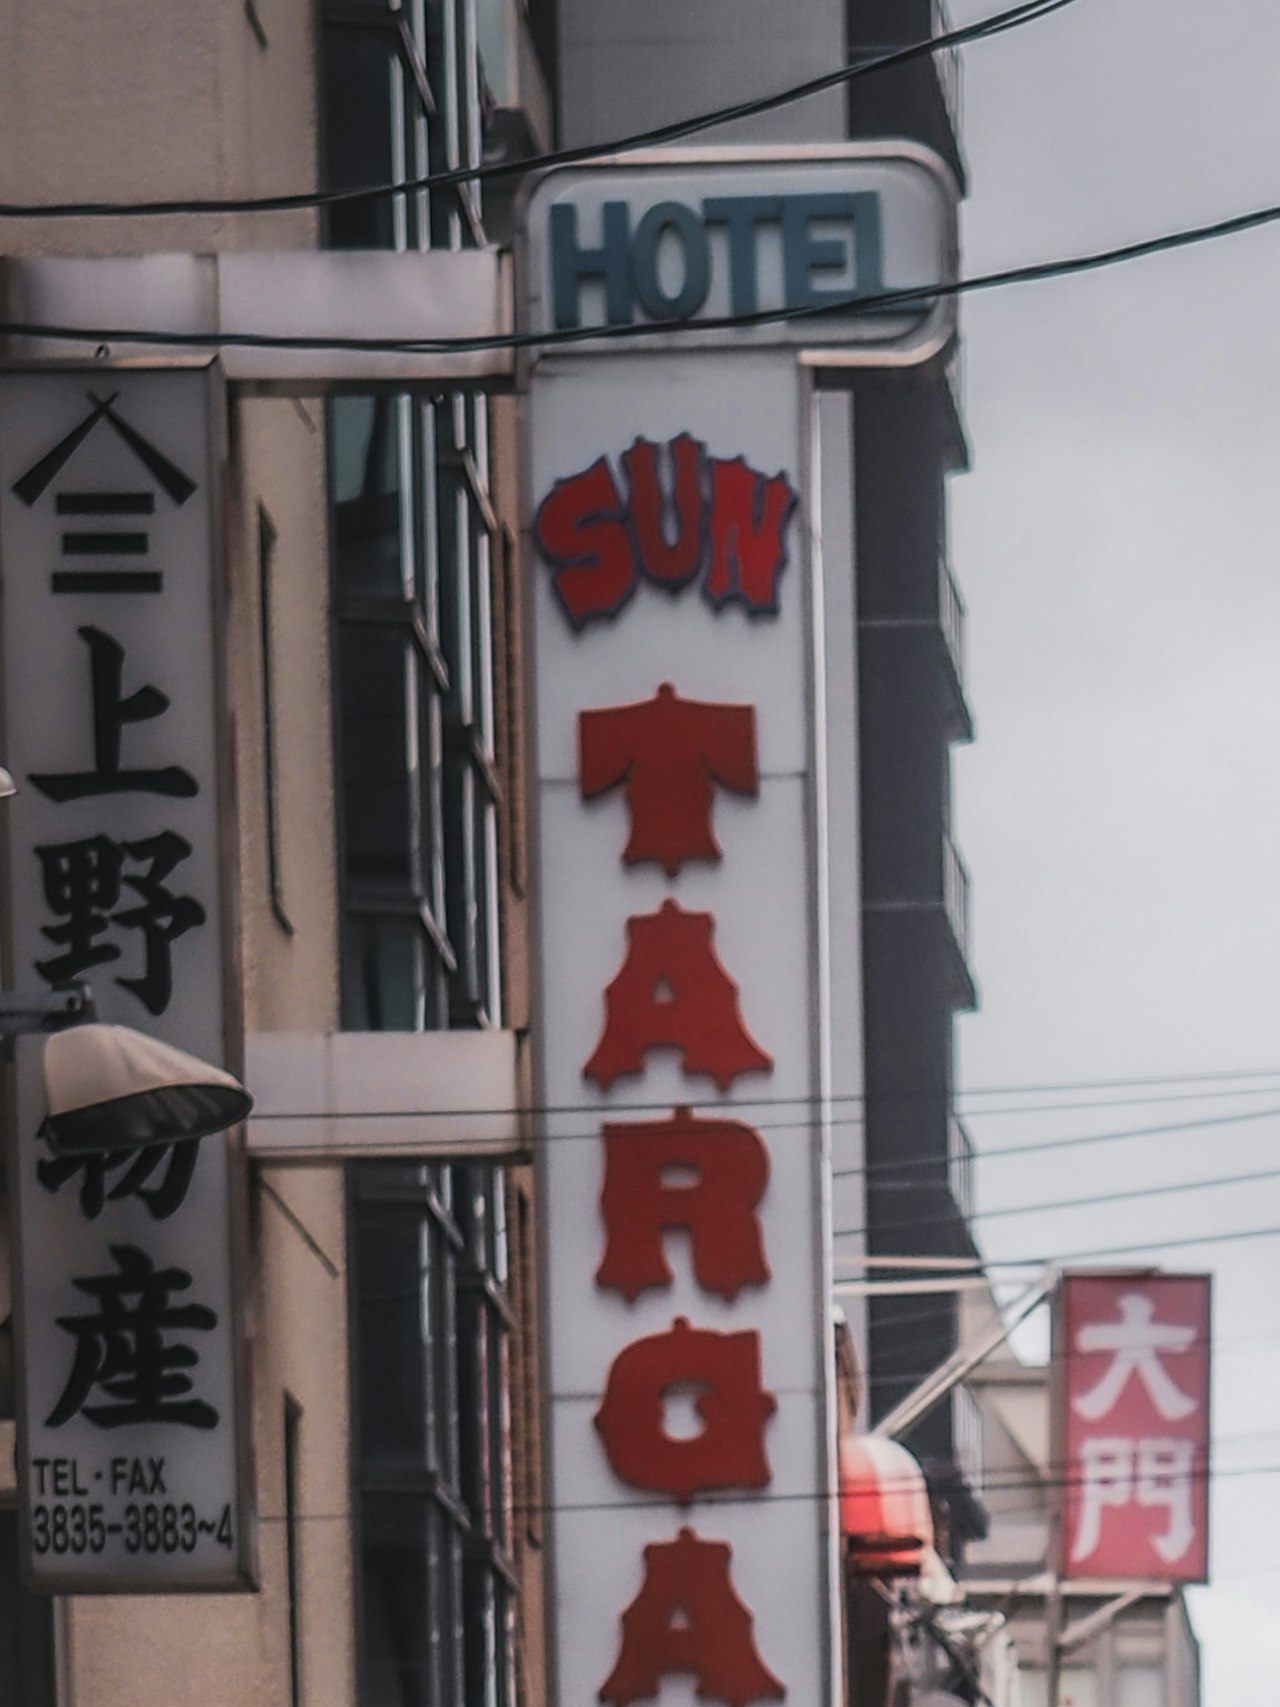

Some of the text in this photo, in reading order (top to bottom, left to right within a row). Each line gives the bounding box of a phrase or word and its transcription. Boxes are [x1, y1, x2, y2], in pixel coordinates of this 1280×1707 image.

[550, 191, 937, 329] HOTEL
[535, 431, 799, 636] SUN
[1070, 1293, 1198, 1564] 大門
